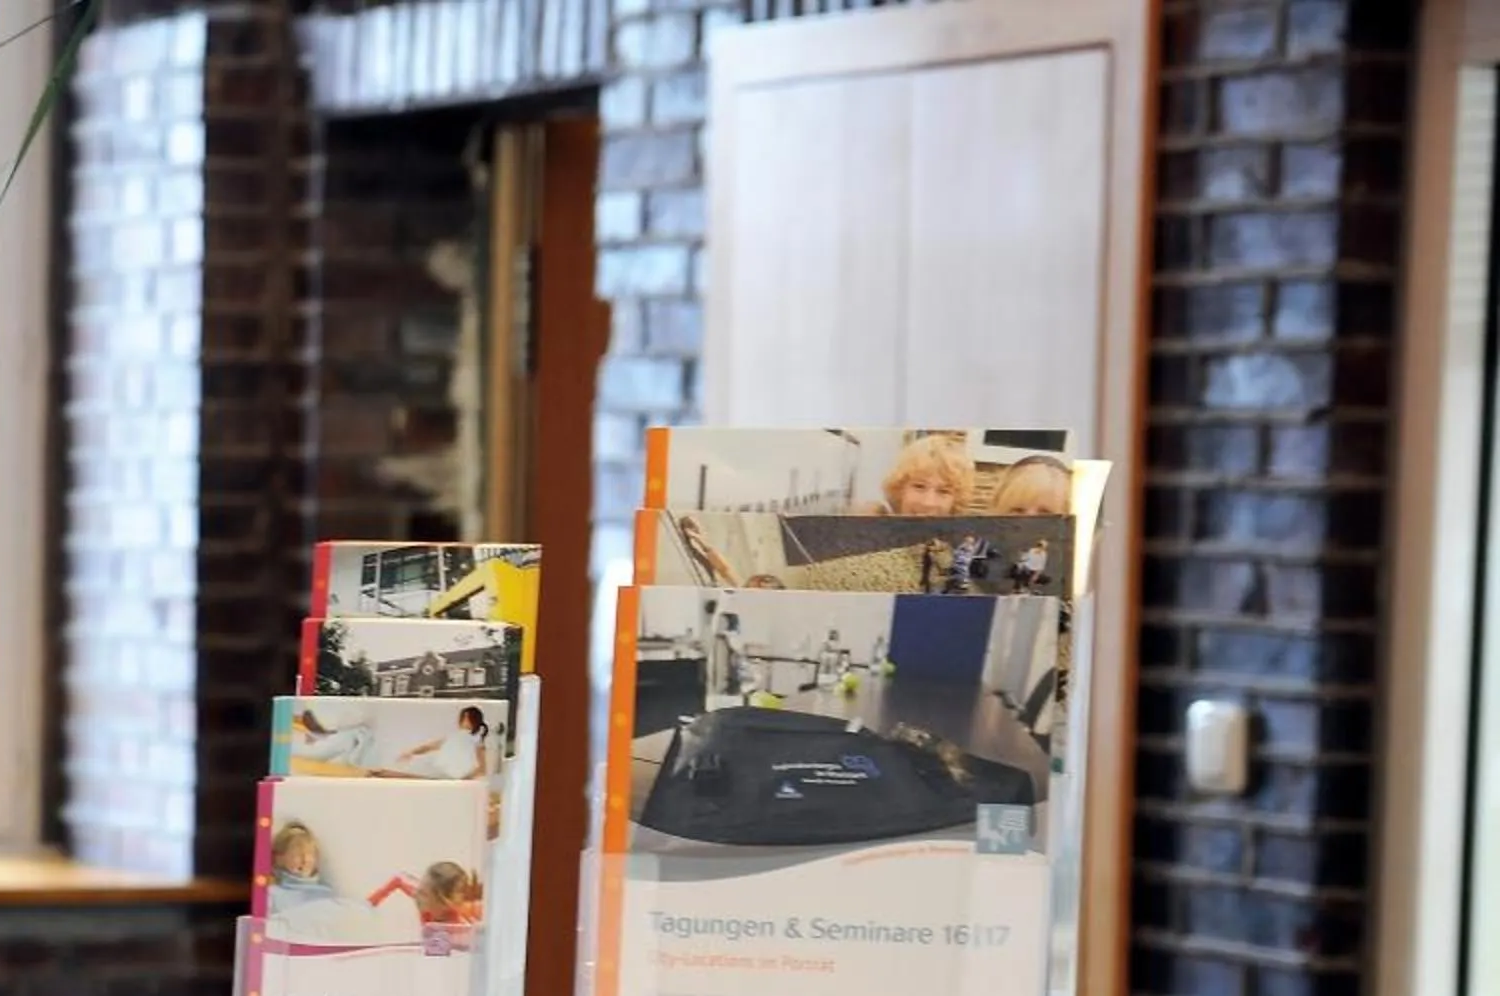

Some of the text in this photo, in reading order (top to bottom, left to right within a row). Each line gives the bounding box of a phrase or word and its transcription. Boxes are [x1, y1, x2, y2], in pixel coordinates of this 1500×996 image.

[647, 910, 775, 941] Tagungen
[784, 916, 804, 939] &
[810, 916, 934, 946] Seminare
